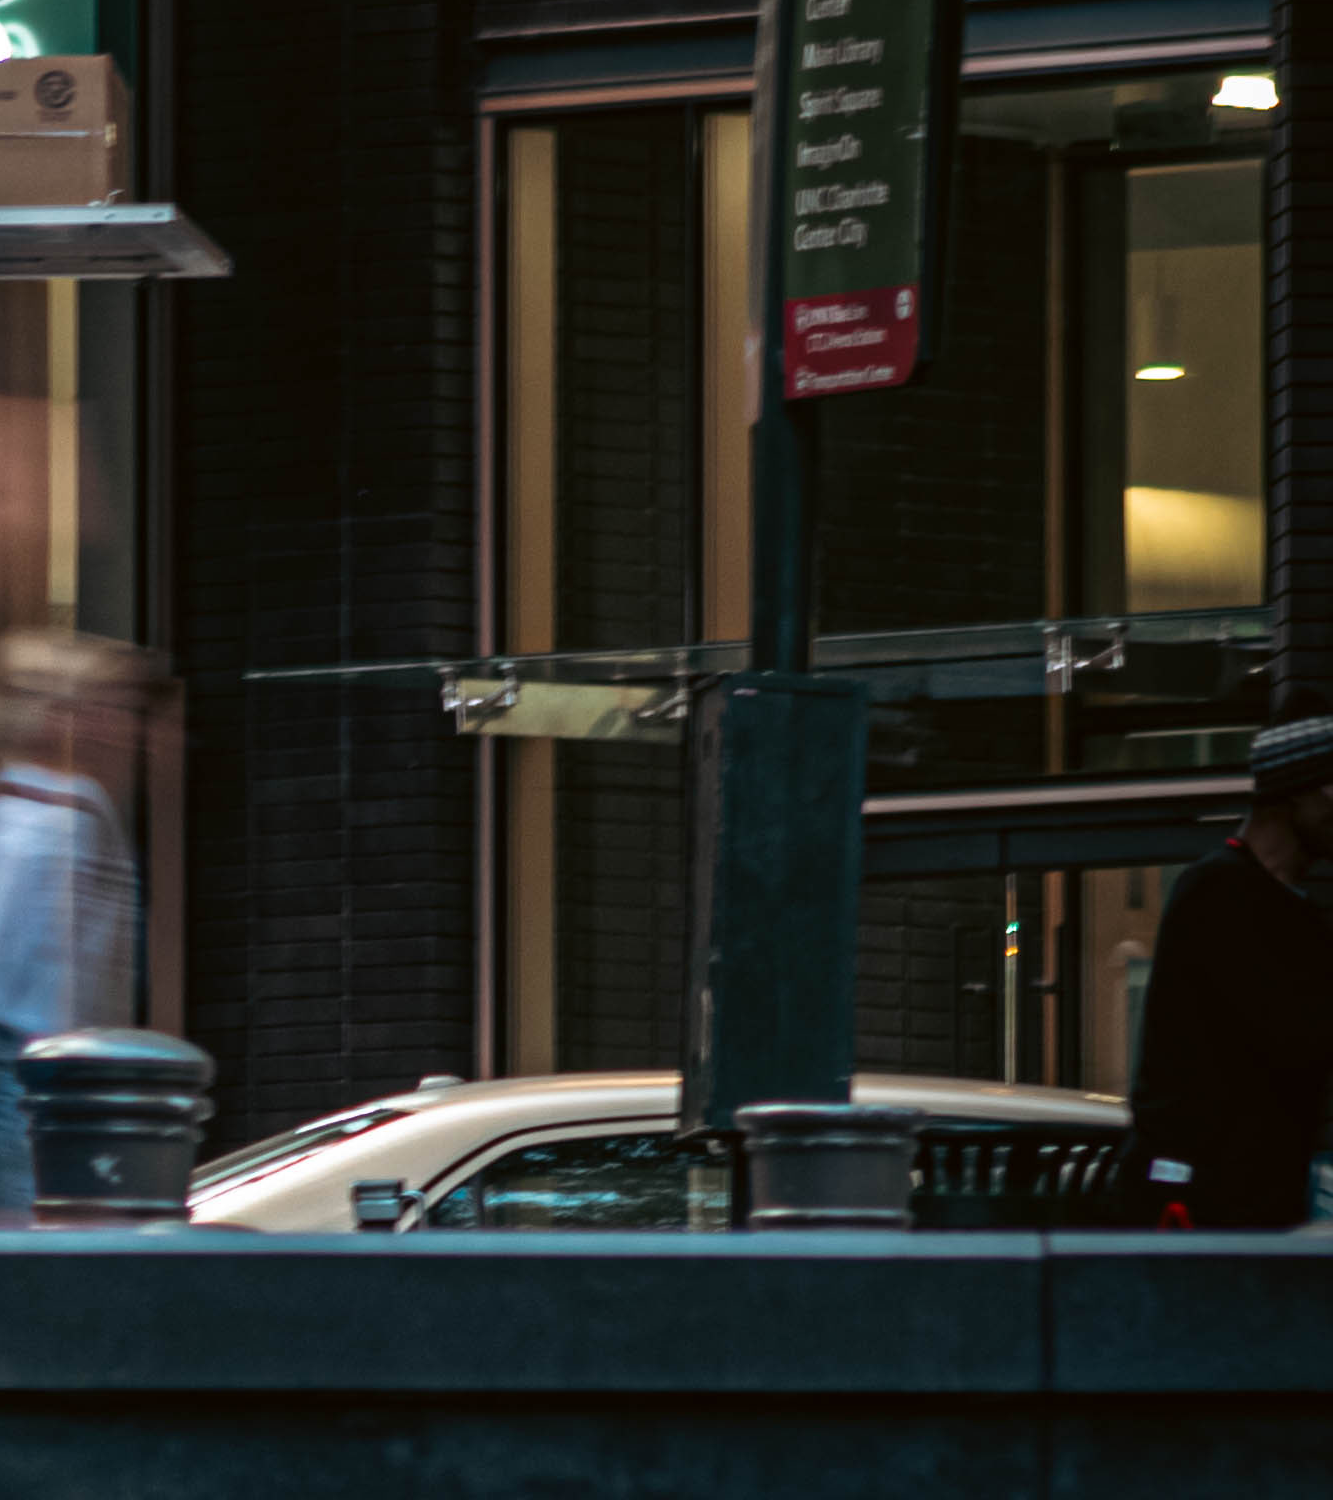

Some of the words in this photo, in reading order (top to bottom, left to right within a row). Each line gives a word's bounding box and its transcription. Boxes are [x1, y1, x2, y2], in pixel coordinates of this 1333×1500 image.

[801, 41, 836, 71] Main
[837, 36, 885, 66] Library
[798, 88, 836, 122] Spirit
[836, 85, 883, 114] Square
[794, 186, 827, 217] UNC
[827, 181, 891, 213] Charlotte
[792, 224, 837, 253] Center
[837, 218, 869, 250] City
